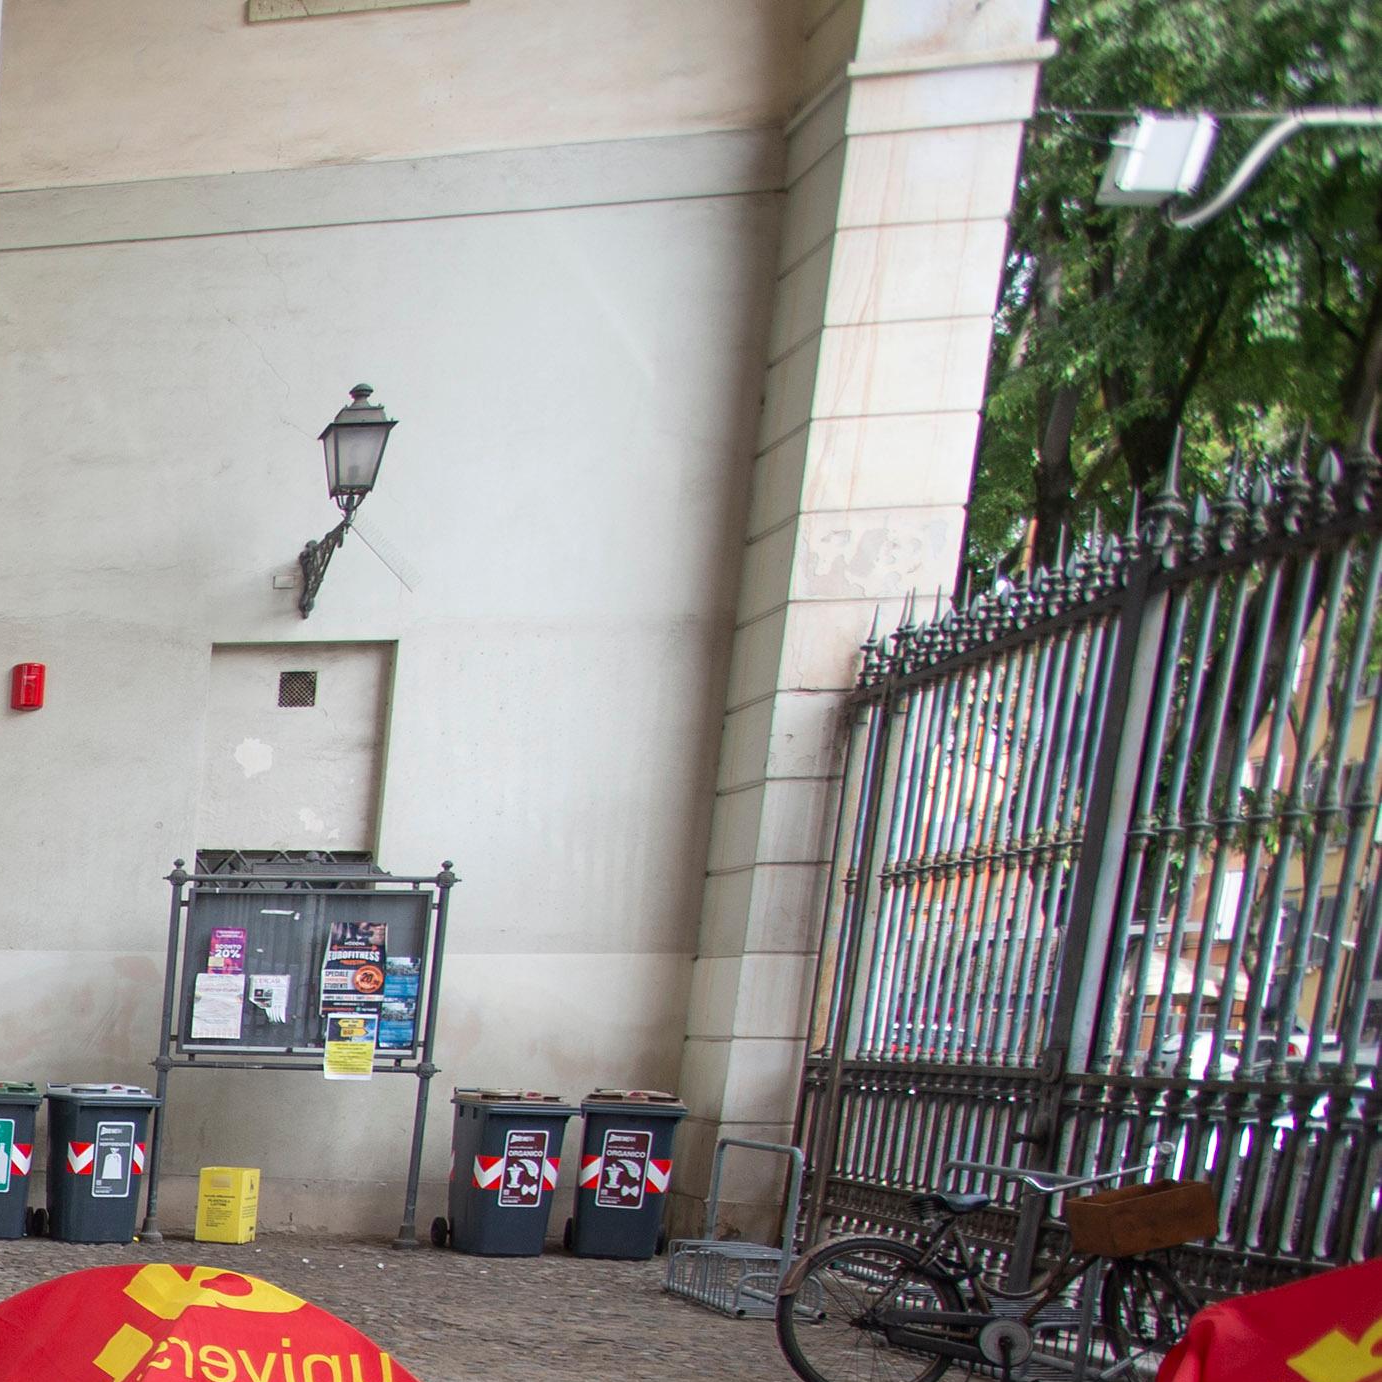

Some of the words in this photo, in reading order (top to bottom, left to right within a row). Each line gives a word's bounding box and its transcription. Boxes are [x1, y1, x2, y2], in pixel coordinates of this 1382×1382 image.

[214, 949, 242, 959] 20%
[327, 951, 380, 962] EUROFITNESS
[606, 1149, 646, 1159] ORGANICO
